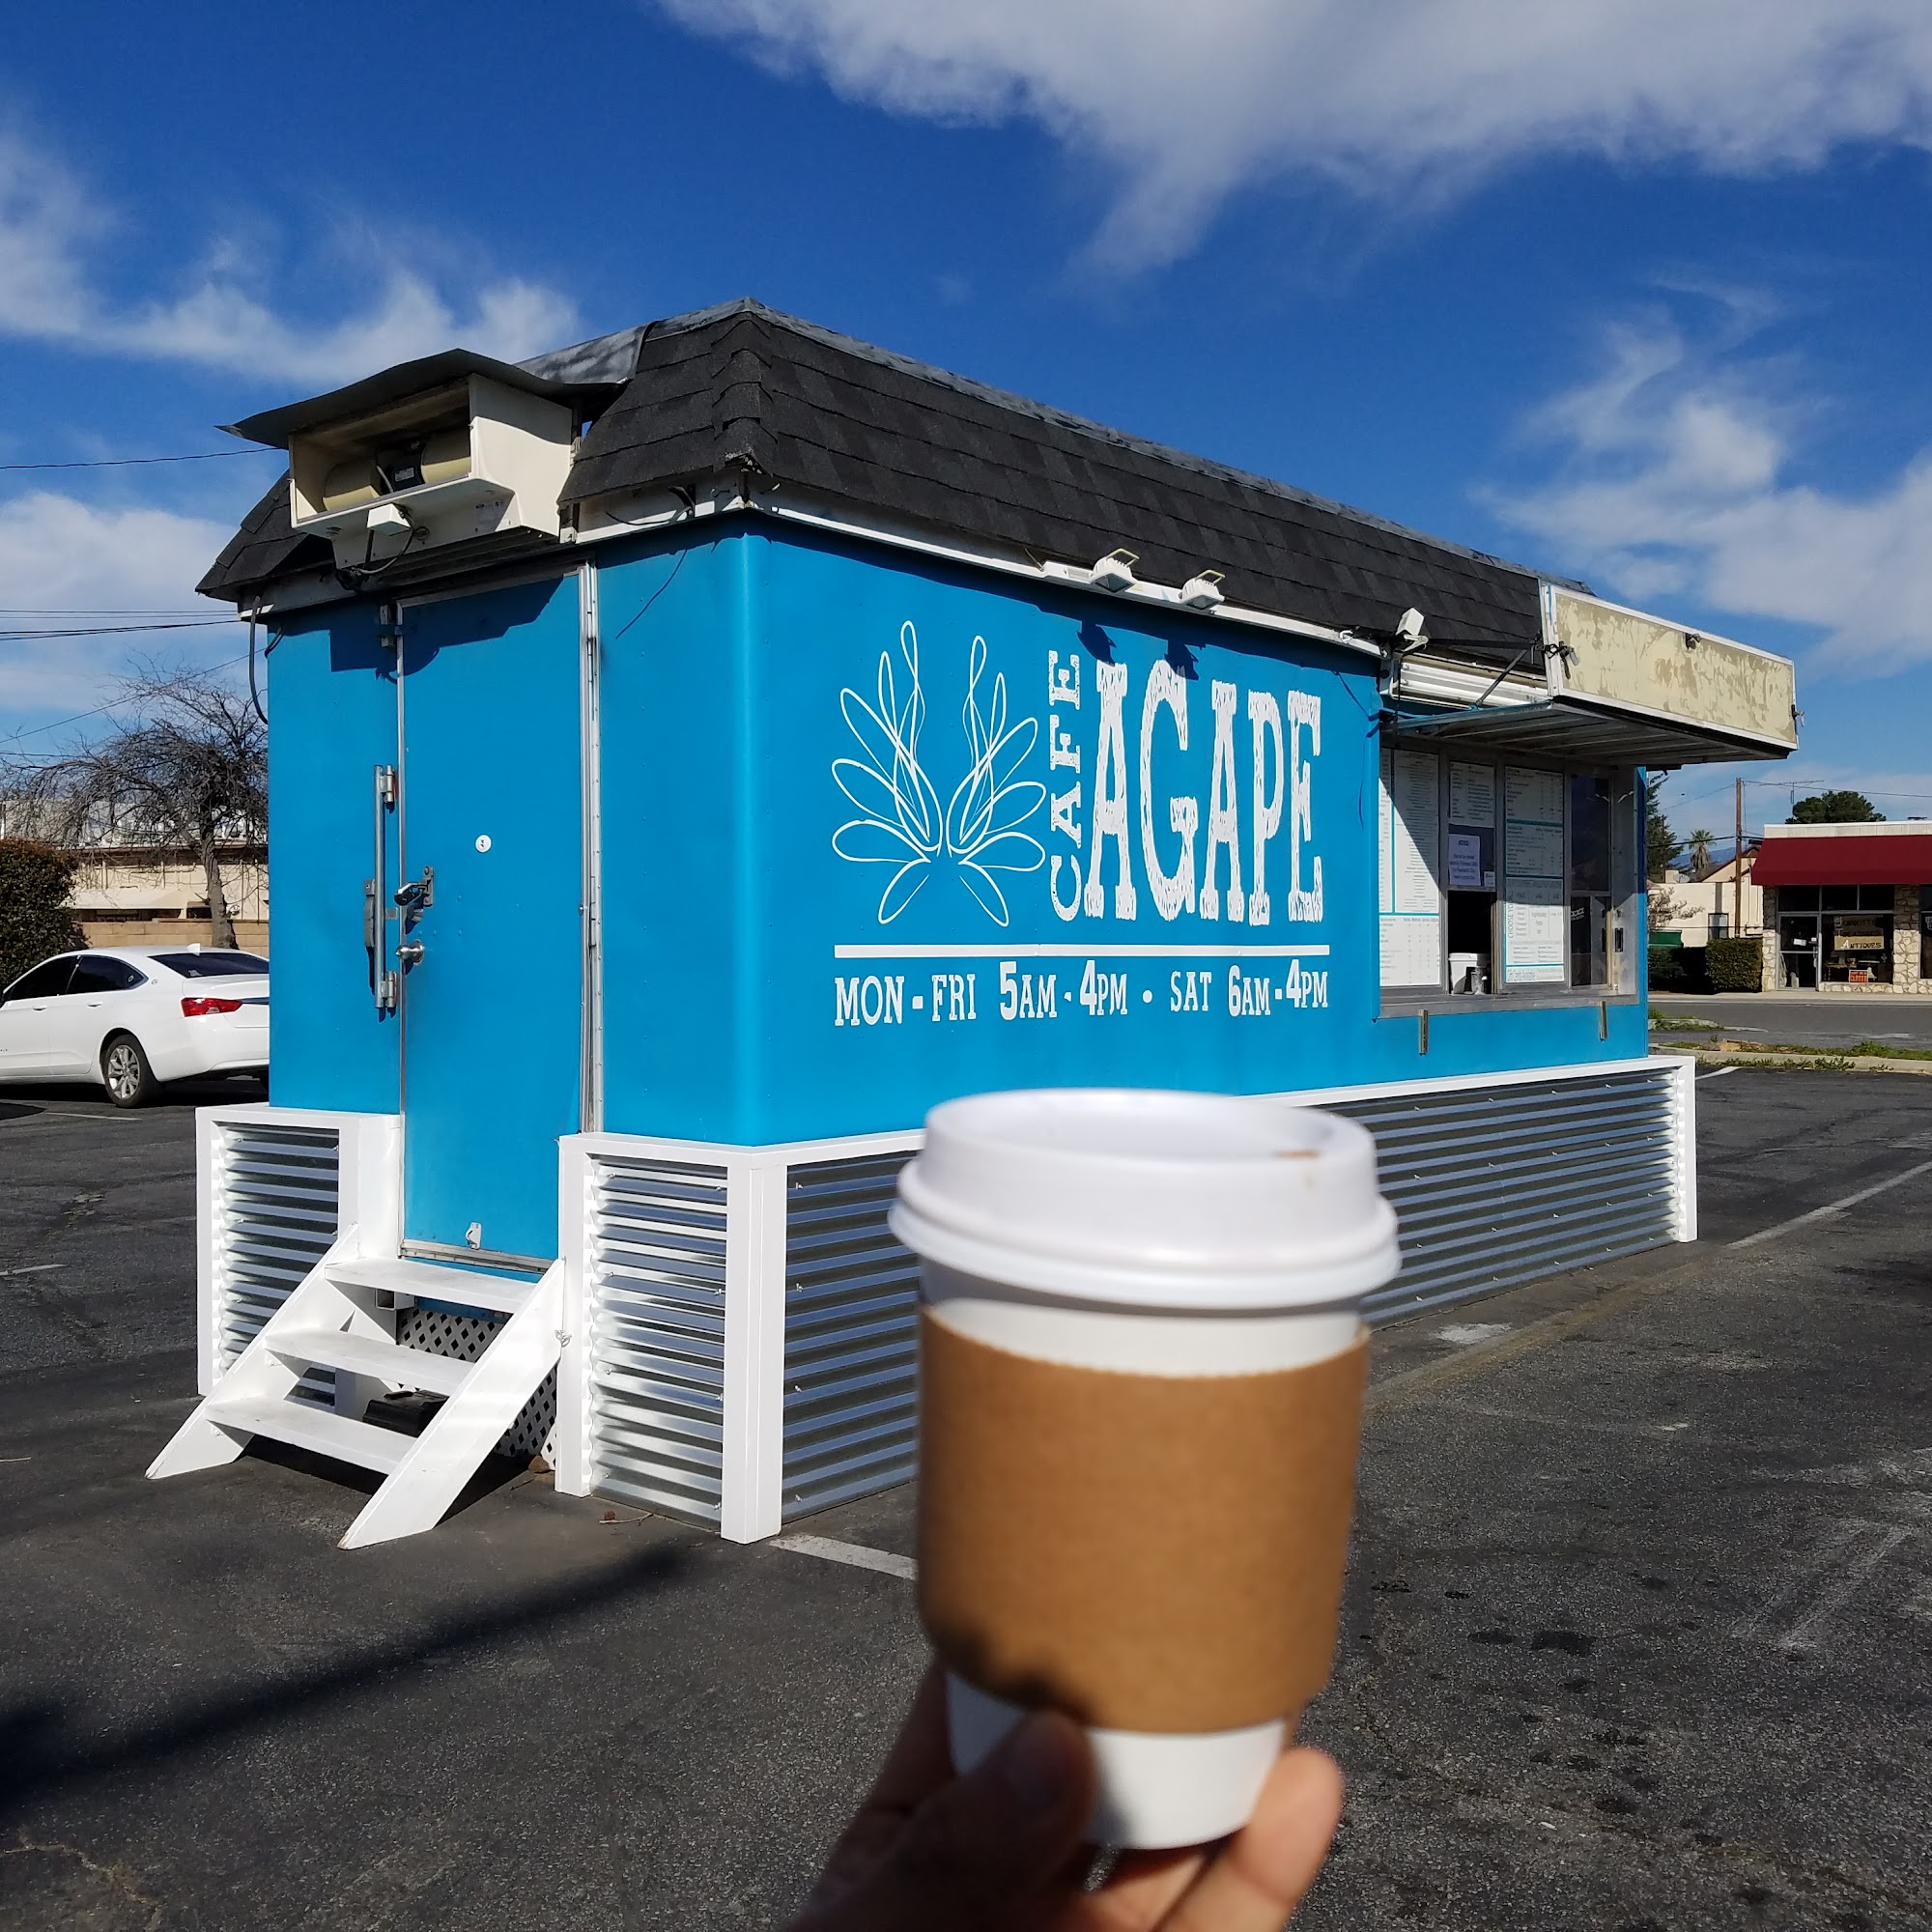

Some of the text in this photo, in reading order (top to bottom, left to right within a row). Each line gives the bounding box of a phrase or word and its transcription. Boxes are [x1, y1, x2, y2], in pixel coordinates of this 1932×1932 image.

[1048, 649, 1082, 923] CAFE
[1083, 659, 1323, 927] AGAPE
[1170, 970, 1212, 1012] SAT
